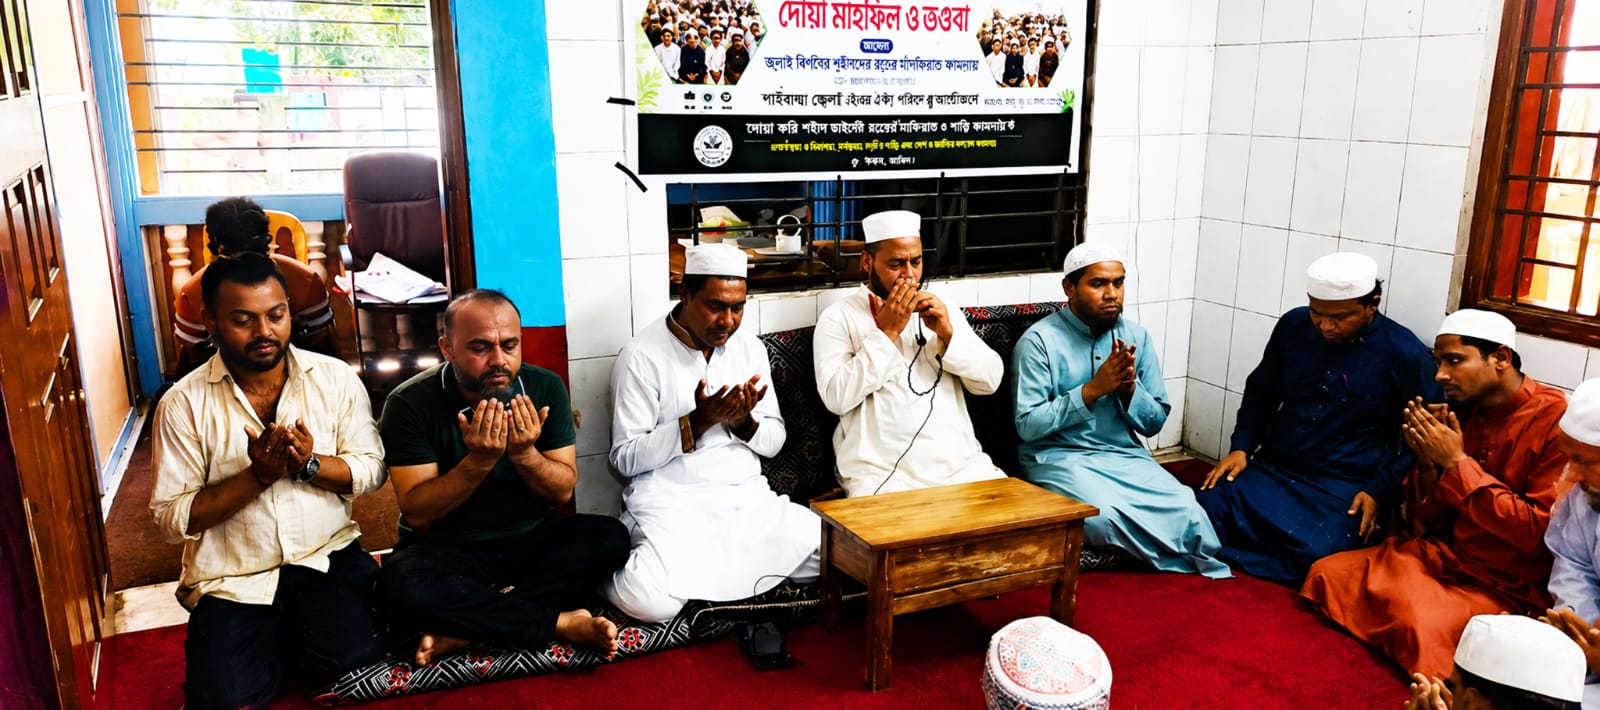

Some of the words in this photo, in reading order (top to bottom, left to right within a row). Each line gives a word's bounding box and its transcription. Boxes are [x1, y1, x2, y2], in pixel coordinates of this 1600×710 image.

[779, 0, 827, 28] দোয়া
[831, 0, 901, 31] মাহফিল
[905, 5, 919, 31] ও
